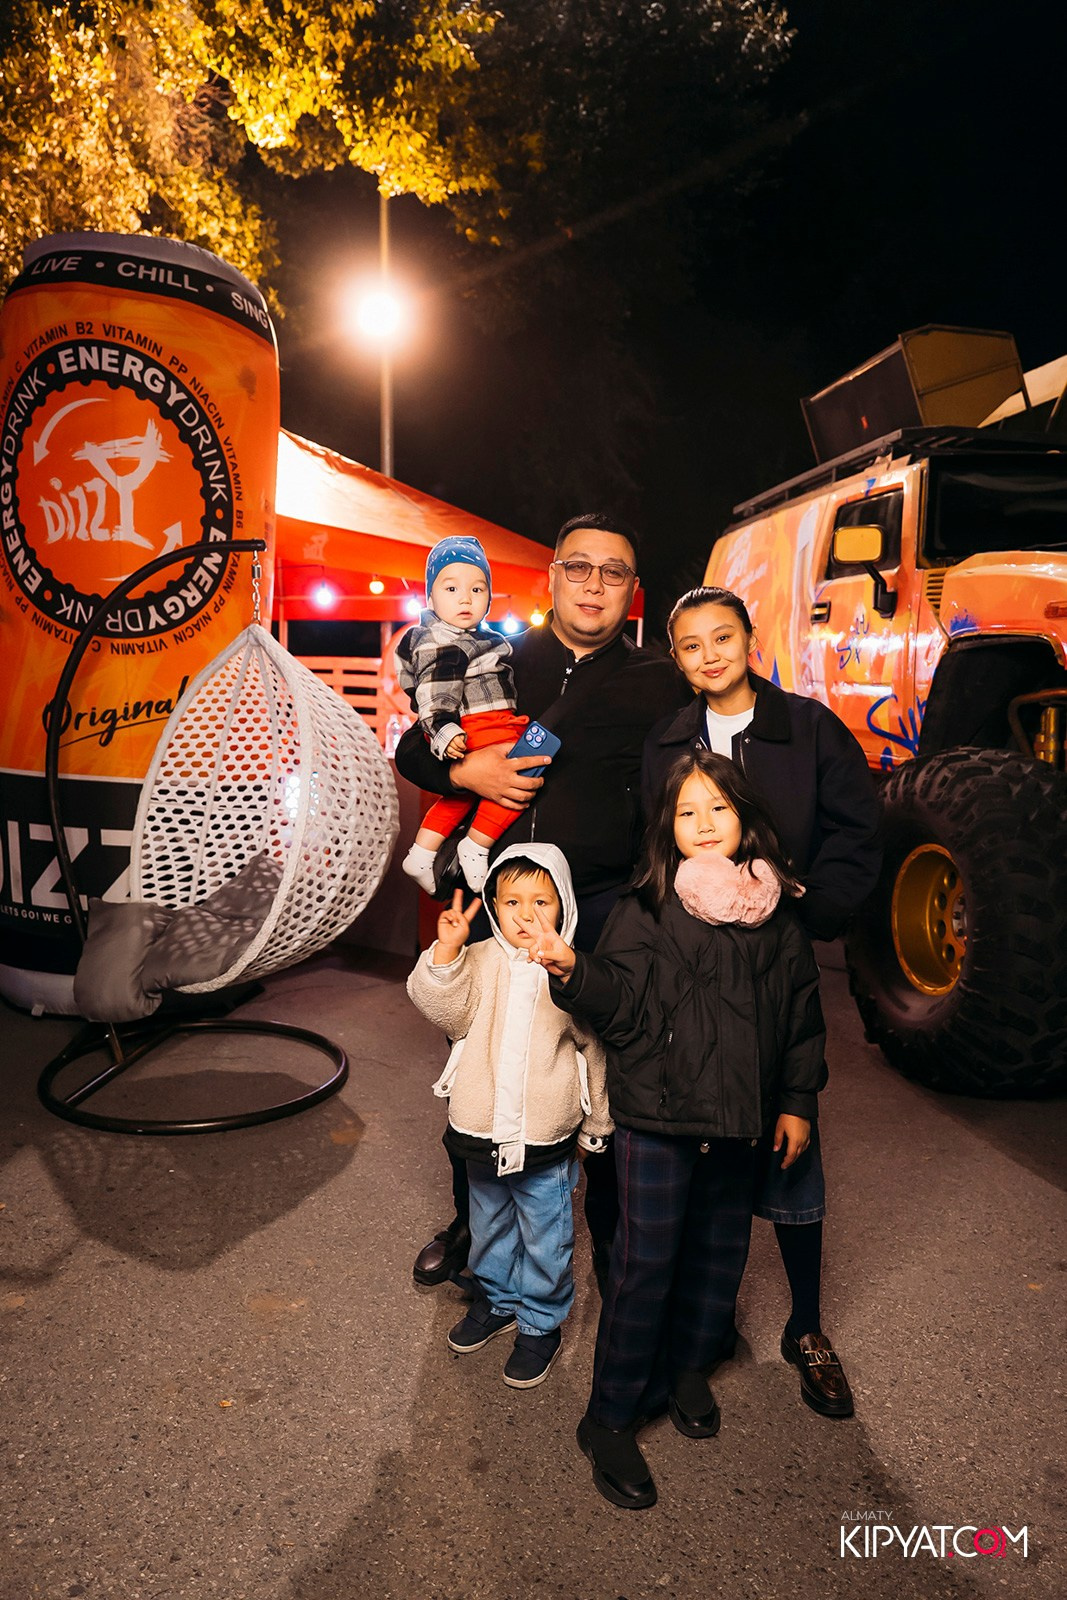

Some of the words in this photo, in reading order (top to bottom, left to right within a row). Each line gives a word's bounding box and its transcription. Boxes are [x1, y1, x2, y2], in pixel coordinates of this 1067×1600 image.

[31, 256, 82, 276] LIVE
[117, 261, 199, 293] CHILL
[231, 291, 269, 329] SING
[75, 321, 95, 335] B2
[102, 323, 163, 358] VITAMIN
[23, 324, 69, 360] VITAMIN
[15, 361, 22, 373] C
[168, 355, 188, 375] PP
[189, 376, 225, 430] NIACIN
[223, 435, 243, 502] VITAMIN
[235, 509, 243, 529] B6
[222, 551, 241, 593] TAMIN
[213, 594, 226, 614] PP
[32, 611, 75, 645] ITAMIN
[173, 611, 213, 645] NIACIN
[91, 640, 102, 652] C
[110, 638, 169, 656] VITAMIN
[21, 909, 40, 920] GO!
[42, 912, 60, 924] WE
